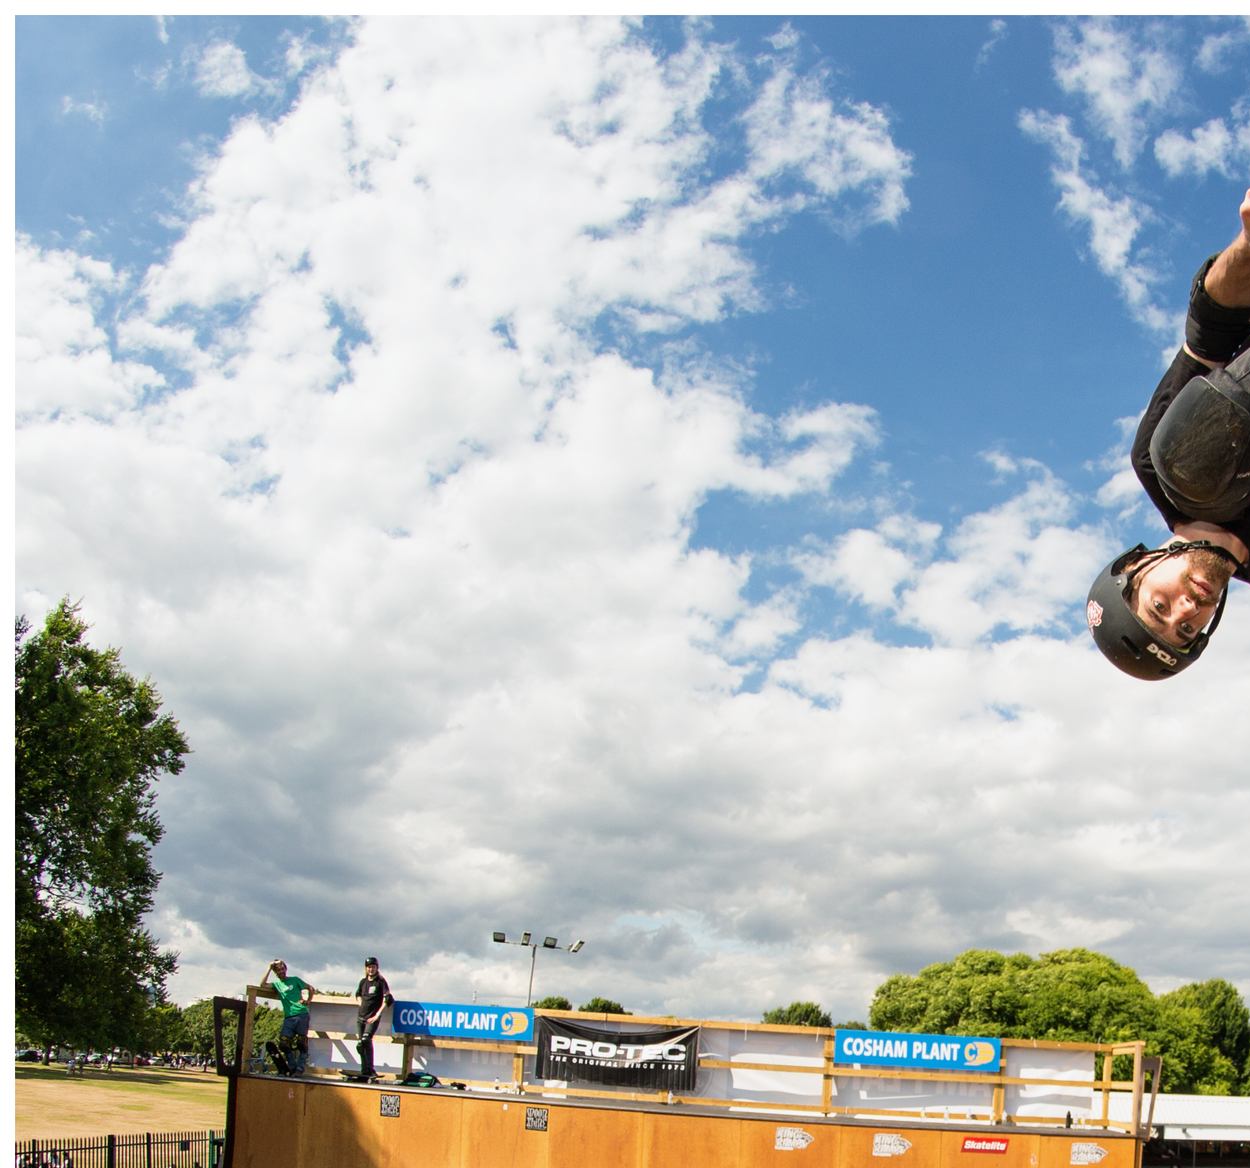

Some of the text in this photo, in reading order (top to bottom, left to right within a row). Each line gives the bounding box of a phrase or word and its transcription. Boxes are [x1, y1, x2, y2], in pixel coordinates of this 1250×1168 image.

[399, 1008, 453, 1029] COSHAM
[456, 1011, 498, 1031] PLANT
[550, 1035, 686, 1061] PRO-TEC
[842, 1036, 908, 1060] COSHAM
[912, 1040, 960, 1062] PLANT
[549, 1055, 686, 1071] THE ORIGINAL SINCE 1973
[964, 1139, 1007, 1151] Skatelite
